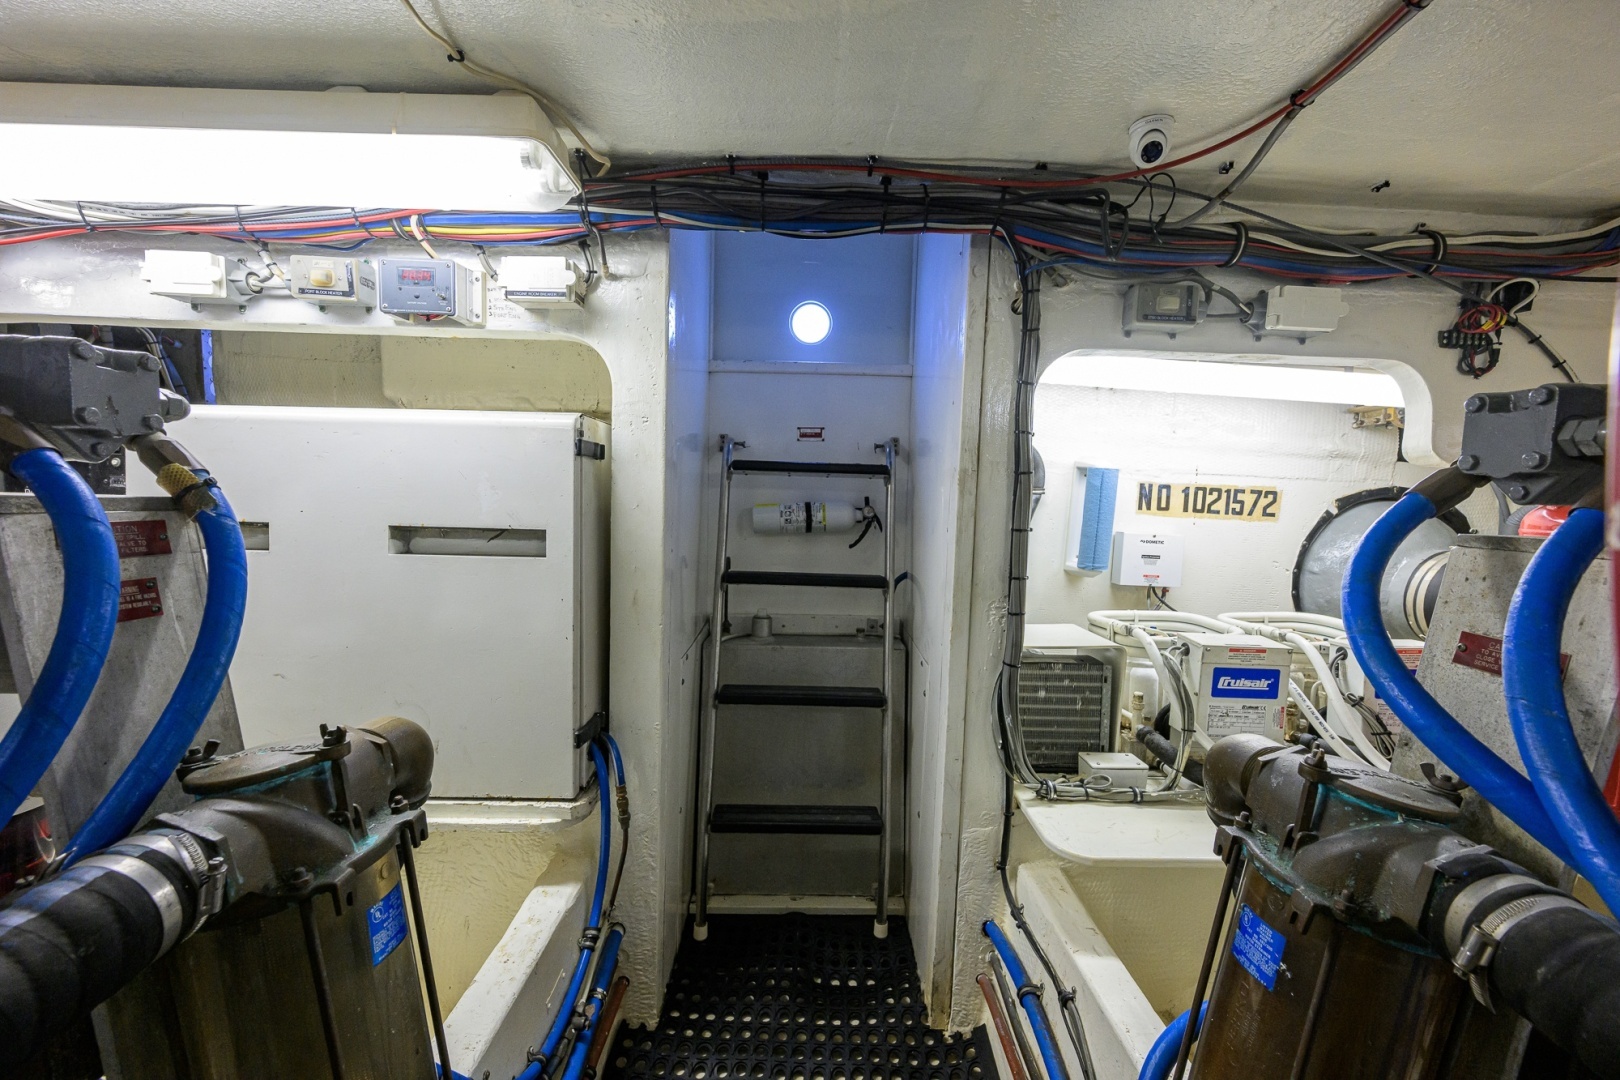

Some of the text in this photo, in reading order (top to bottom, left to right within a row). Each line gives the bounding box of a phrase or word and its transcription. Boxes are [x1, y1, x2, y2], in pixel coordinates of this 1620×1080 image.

[1182, 486, 1278, 518] 1021572
[1476, 654, 1495, 663] CLOSE
[1474, 660, 1498, 670] SERVICE
